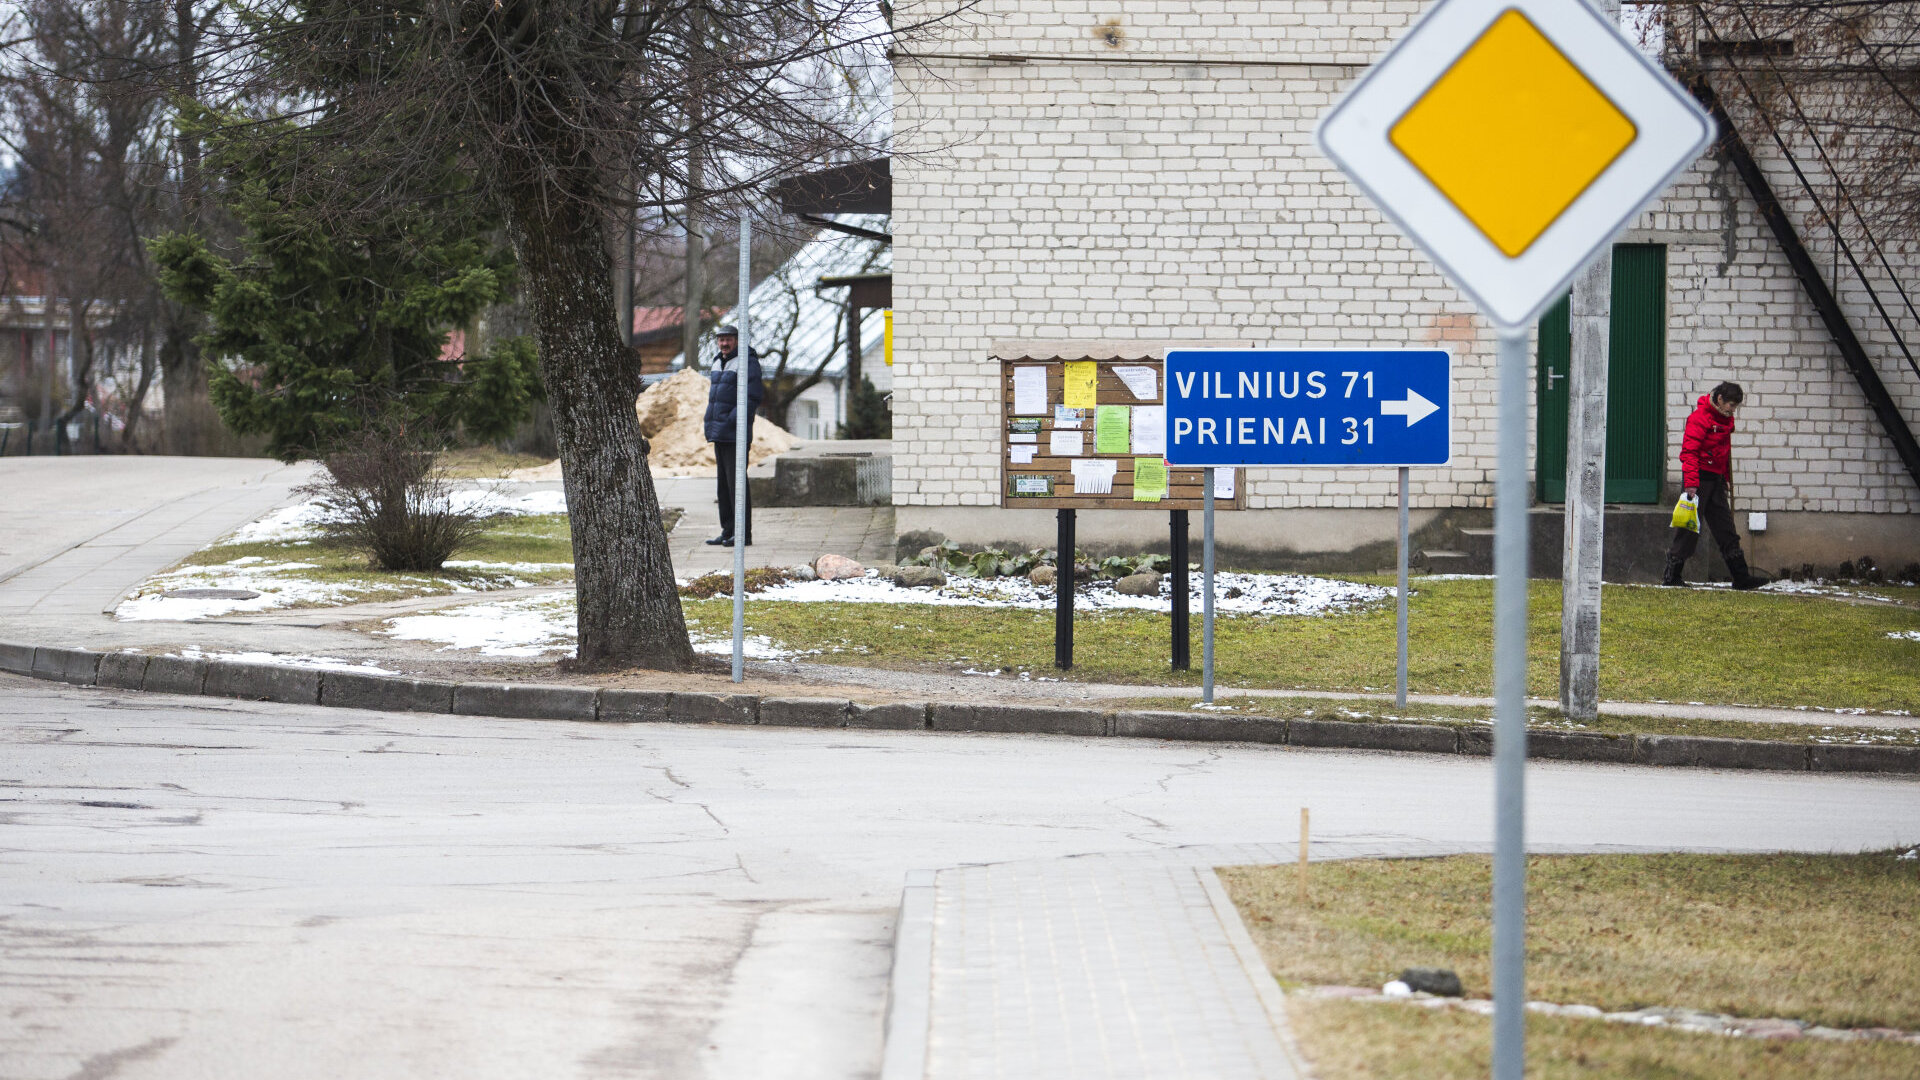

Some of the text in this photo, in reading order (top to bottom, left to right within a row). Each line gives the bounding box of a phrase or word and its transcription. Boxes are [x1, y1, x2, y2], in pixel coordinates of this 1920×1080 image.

[1176, 371, 1327, 399] VILNIUS
[1342, 371, 1374, 399] 71
[1175, 417, 1326, 445] PRIENAI
[1341, 417, 1374, 445] 31
